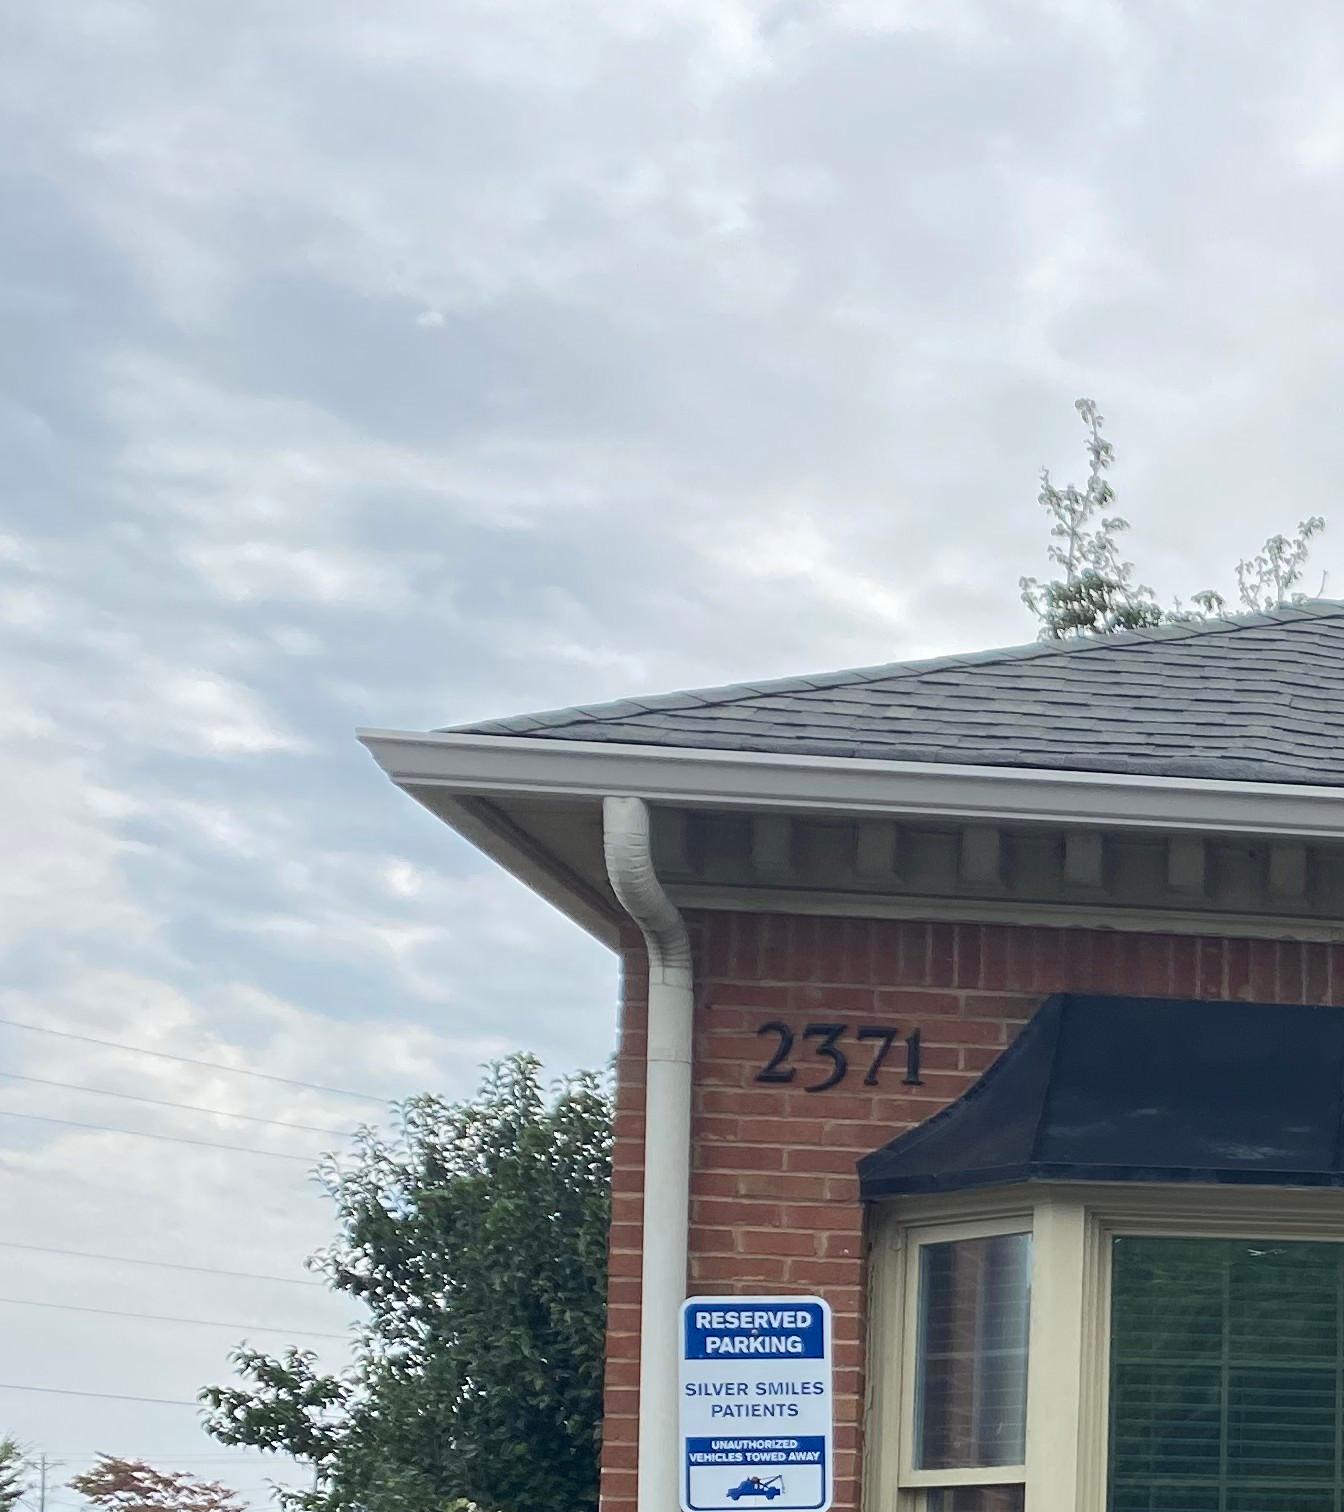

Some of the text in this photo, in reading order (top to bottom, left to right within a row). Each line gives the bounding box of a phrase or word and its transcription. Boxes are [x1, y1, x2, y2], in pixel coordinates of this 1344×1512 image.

[755, 1021, 926, 1092] 2371
[696, 1311, 811, 1328] RESERVED
[706, 1336, 802, 1353] PARKING
[685, 1381, 824, 1396] SILVER SMILES
[712, 1404, 798, 1417] PATIENTS
[712, 1440, 797, 1450] UNAUTHORIZED
[690, 1452, 820, 1462] VEHICLES TOWED AWAY
